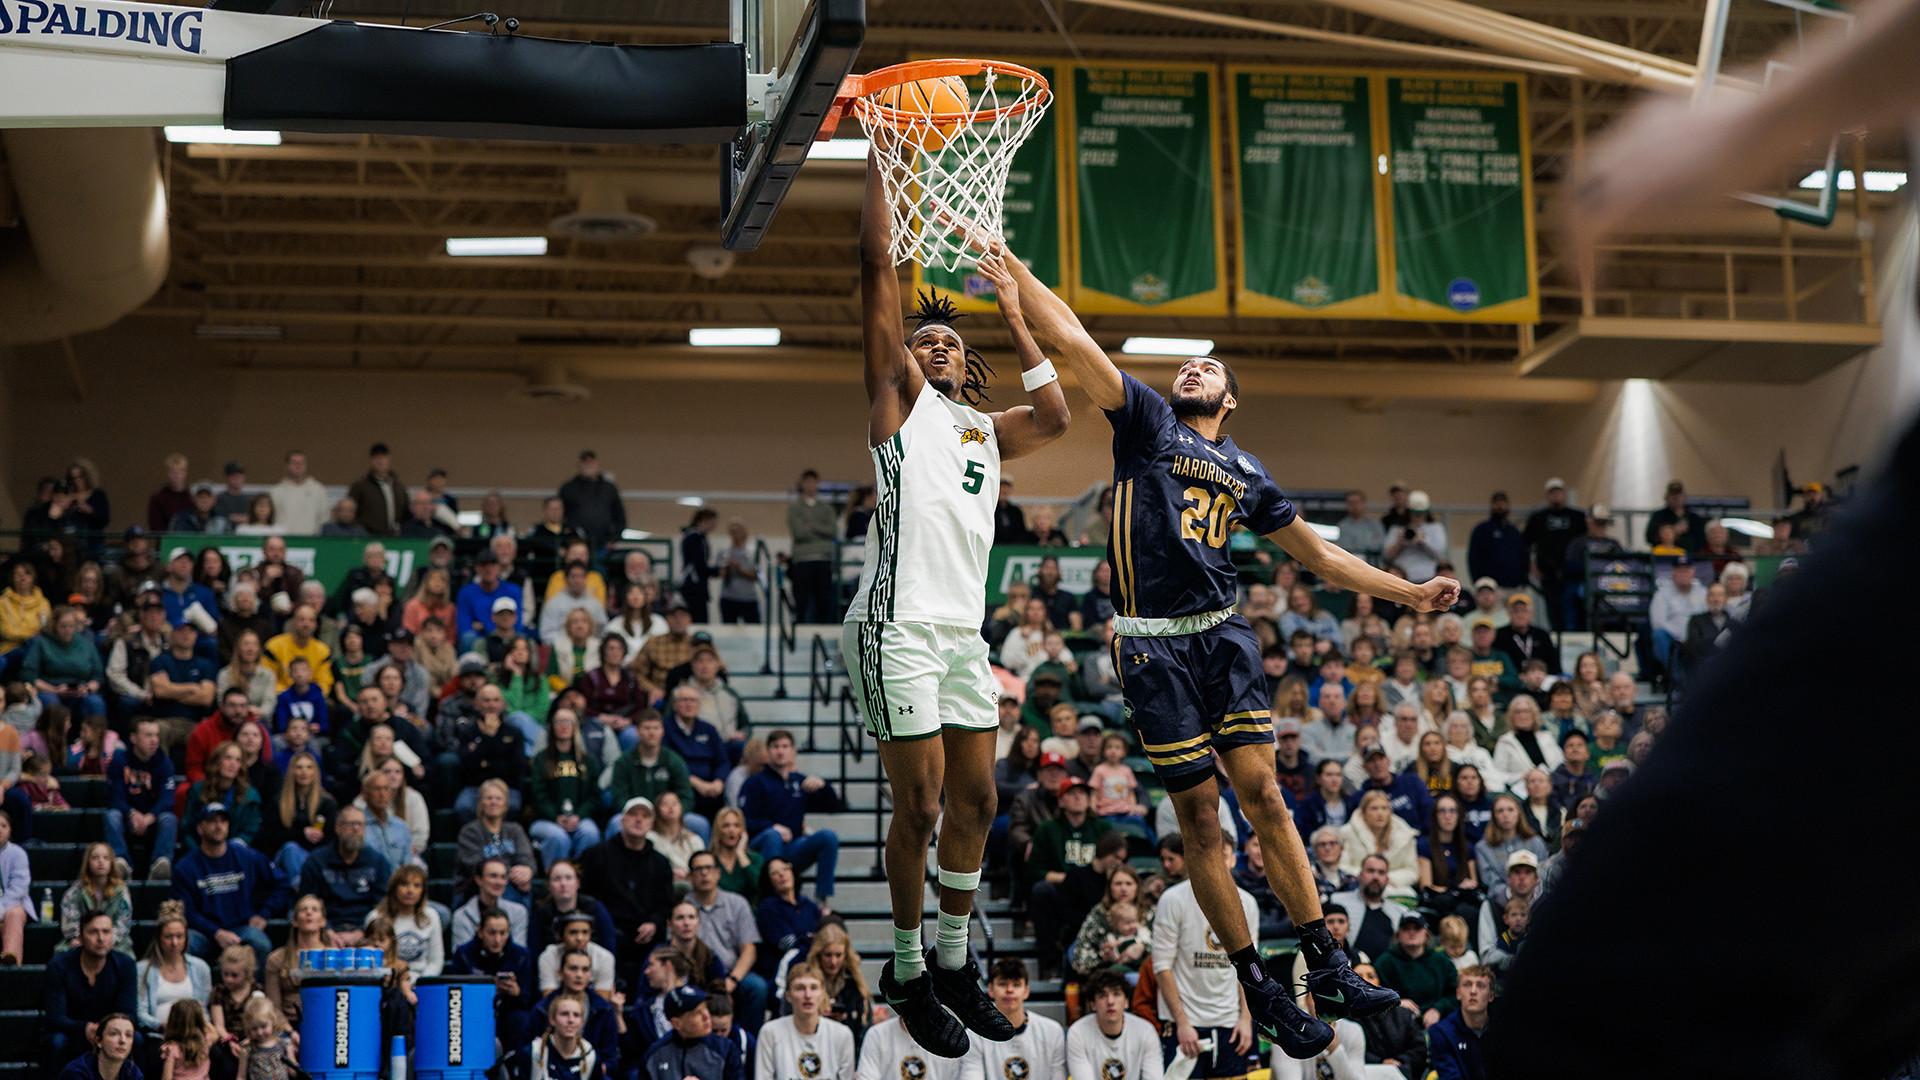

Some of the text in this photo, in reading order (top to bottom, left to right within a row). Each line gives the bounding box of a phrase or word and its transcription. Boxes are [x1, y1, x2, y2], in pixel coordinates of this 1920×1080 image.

[1092, 111, 1194, 128] CHAMPIONSHIPS
[1254, 130, 1356, 147] CHAMPIONSHIPS
[962, 459, 985, 495] 5
[1181, 486, 1236, 549] 20
[336, 991, 349, 1066] POWERADE
[449, 989, 462, 1065] POWERADE
